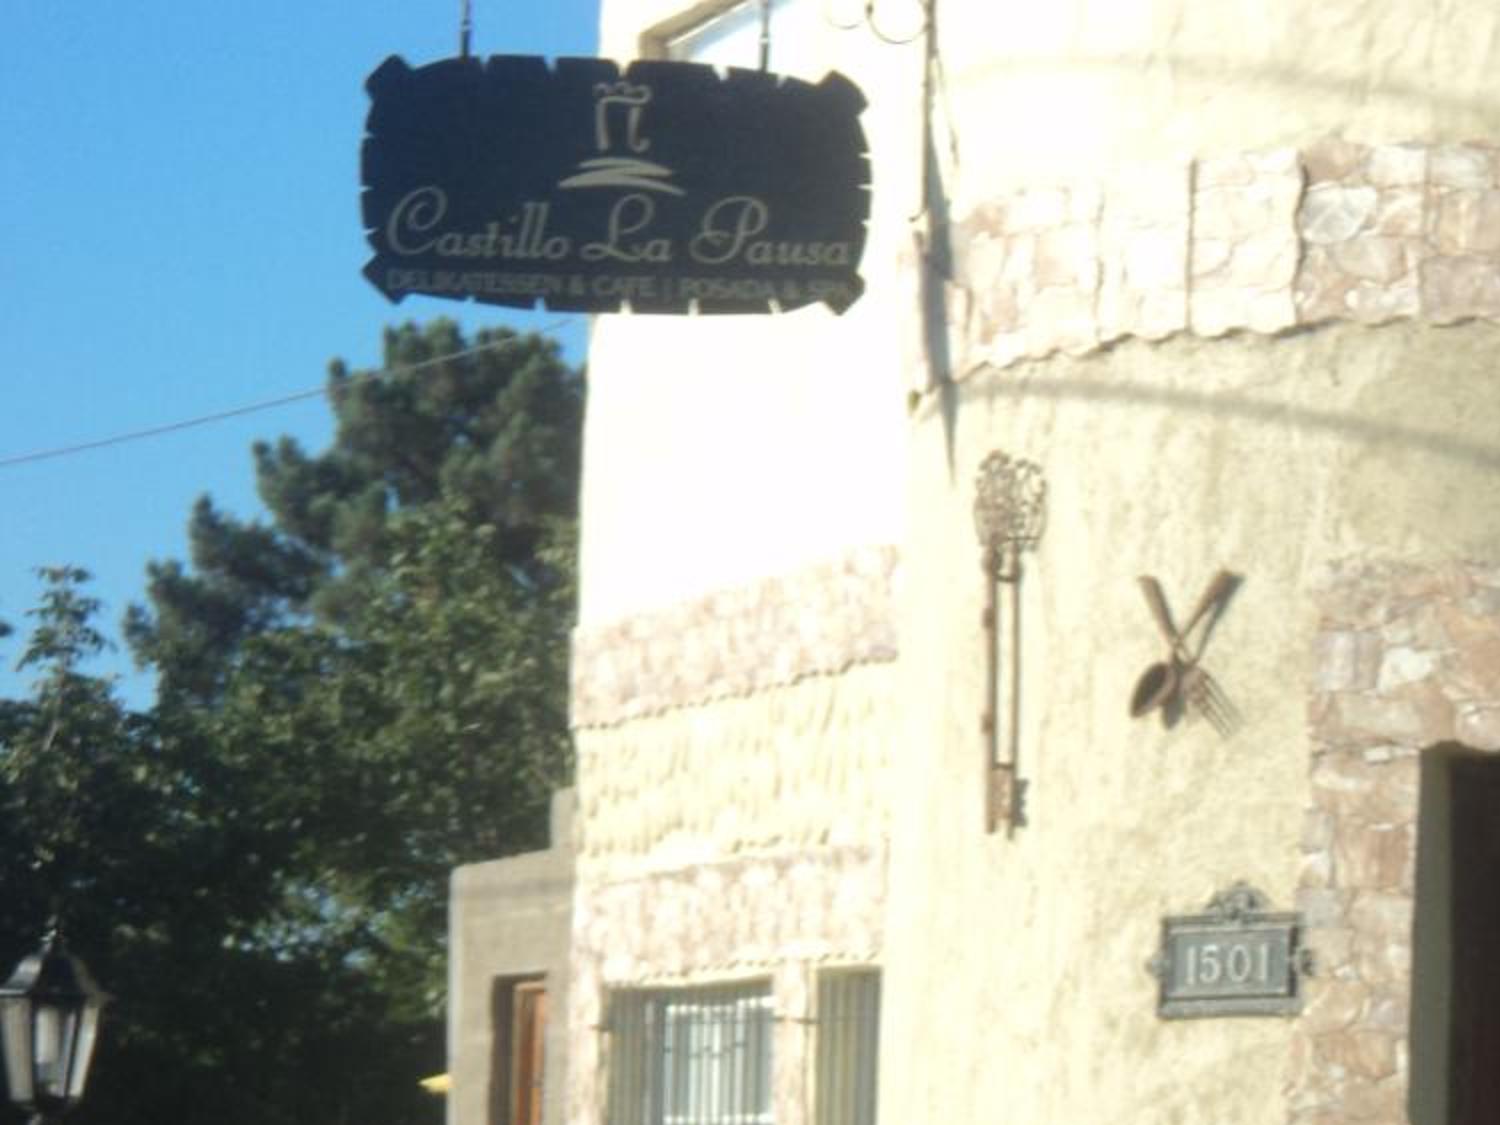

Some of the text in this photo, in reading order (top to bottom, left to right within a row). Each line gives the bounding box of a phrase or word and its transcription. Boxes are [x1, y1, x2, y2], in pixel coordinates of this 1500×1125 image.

[387, 187, 850, 265] Castillo La Pausa
[680, 277, 776, 300] POSADA
[1185, 944, 1269, 985] 1501
